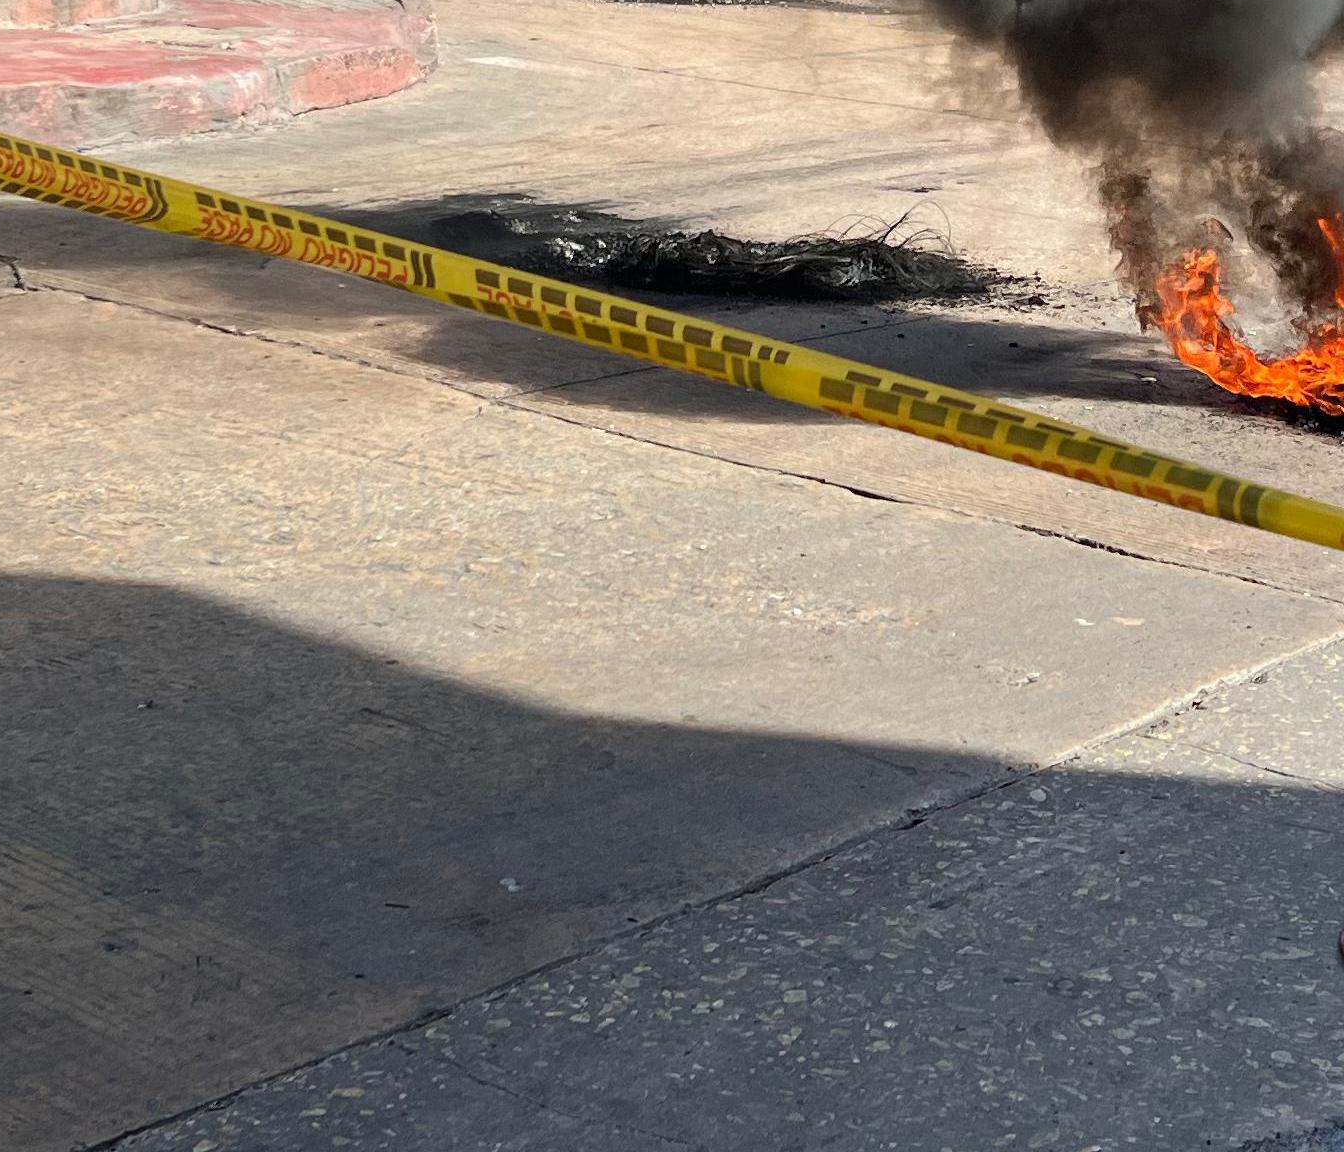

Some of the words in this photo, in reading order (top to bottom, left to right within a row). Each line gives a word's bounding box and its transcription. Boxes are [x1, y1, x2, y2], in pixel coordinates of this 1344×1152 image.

[27, 157, 57, 188] NO
[60, 167, 152, 216] PELIGRO
[194, 205, 255, 246] PASE
[255, 223, 293, 257] NO
